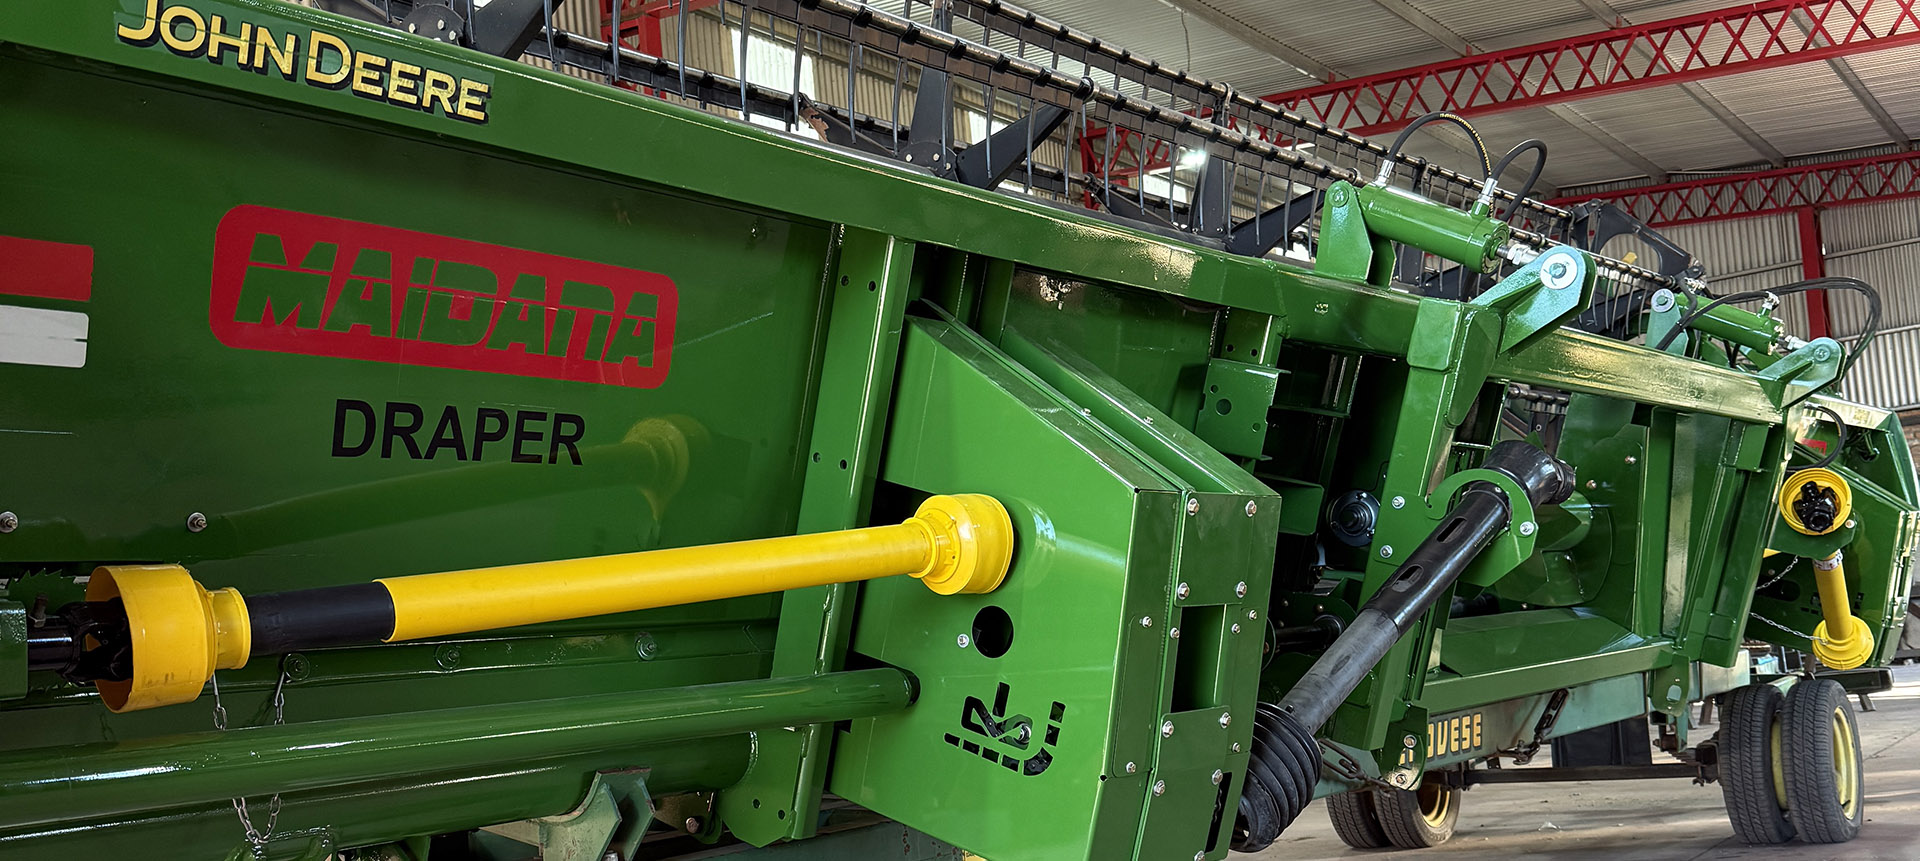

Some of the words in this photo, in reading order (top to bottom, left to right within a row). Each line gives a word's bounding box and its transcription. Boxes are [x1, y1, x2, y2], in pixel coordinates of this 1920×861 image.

[117, 0, 299, 79] JOHN
[305, 30, 490, 123] DEERE
[233, 232, 659, 368] MAIDANA
[331, 399, 586, 466] DRAPER
